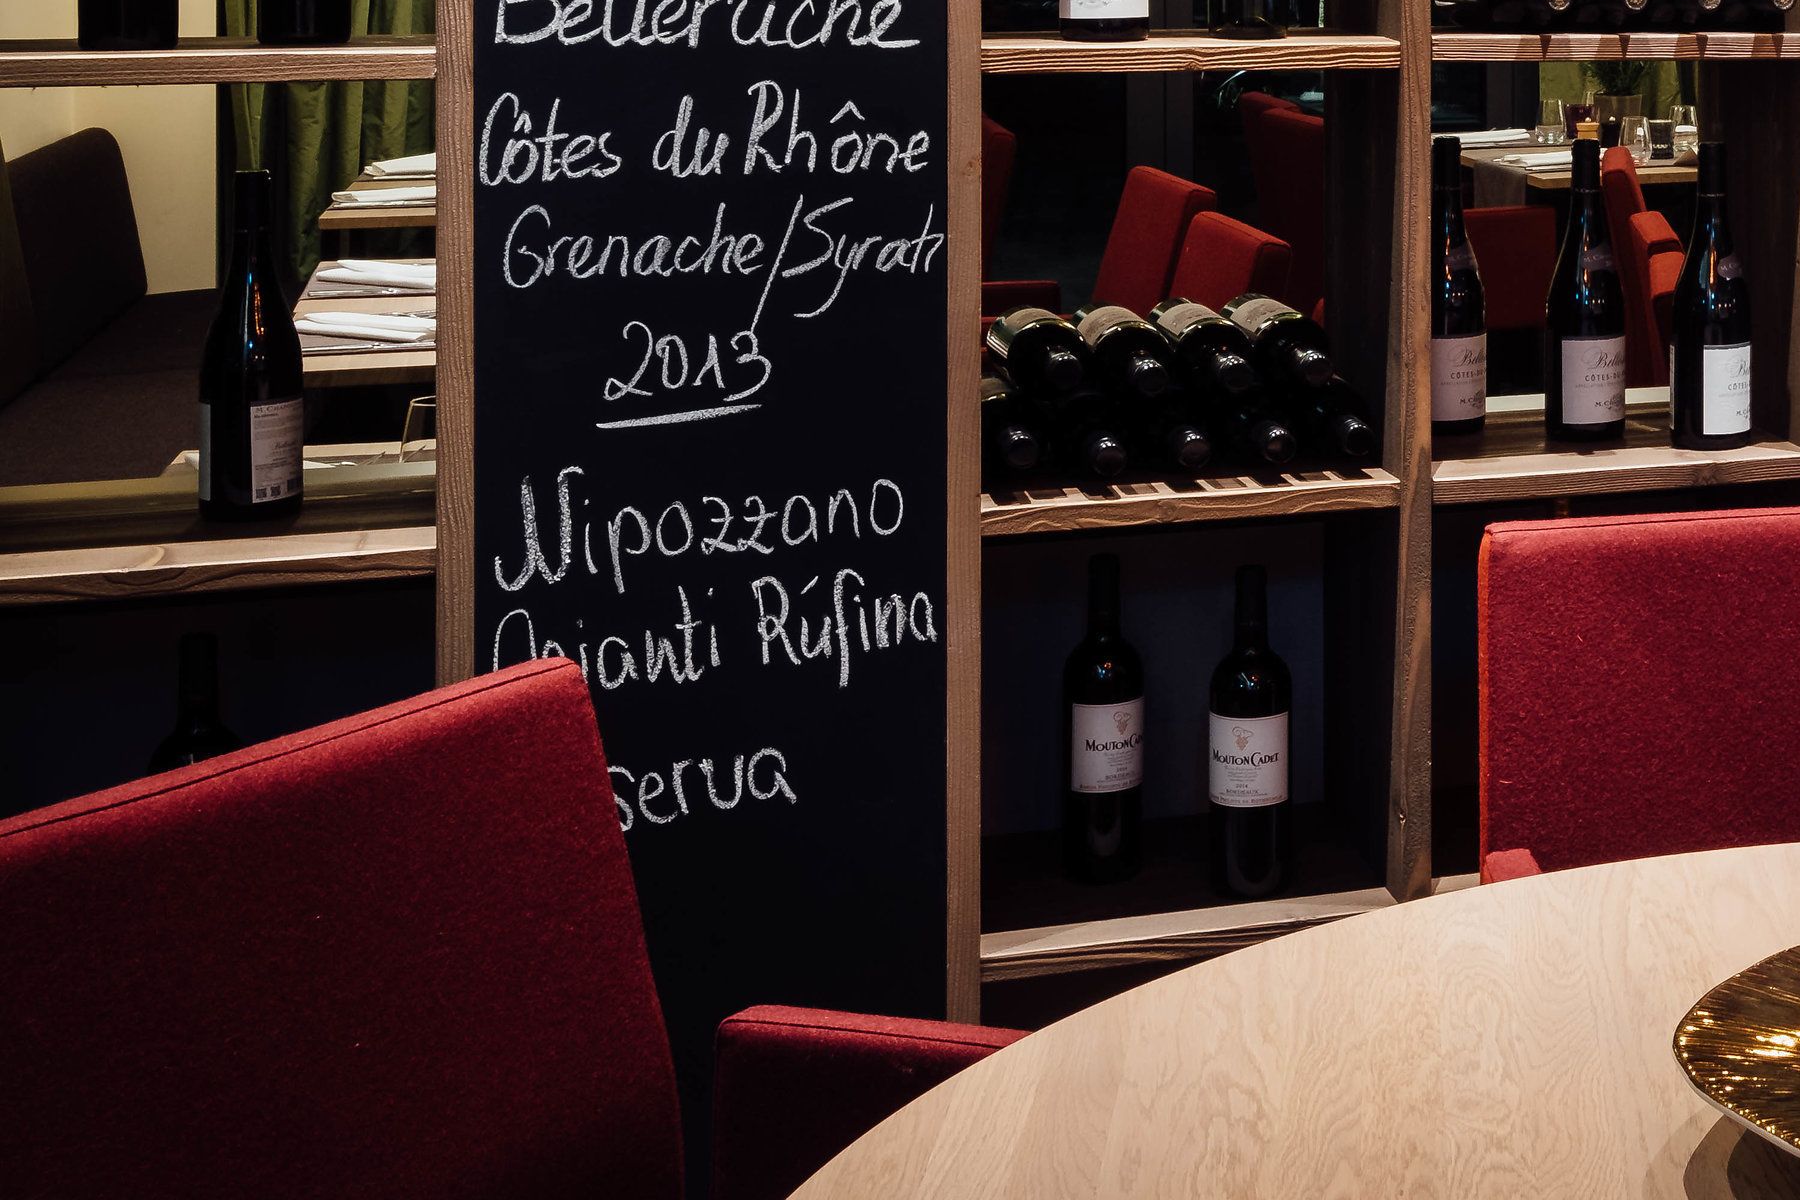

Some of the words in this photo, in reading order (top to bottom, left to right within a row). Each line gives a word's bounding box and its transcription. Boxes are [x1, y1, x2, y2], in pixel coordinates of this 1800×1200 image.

[479, 92, 622, 186] Côtes
[652, 94, 730, 178] du
[743, 79, 930, 175] Rhône
[603, 320, 773, 402] 2013
[495, 466, 903, 593] Nipozzano
[1085, 739, 1129, 752] MOUTON
[1212, 748, 1250, 766] MOUTON
[1251, 751, 1280, 767] CADET
